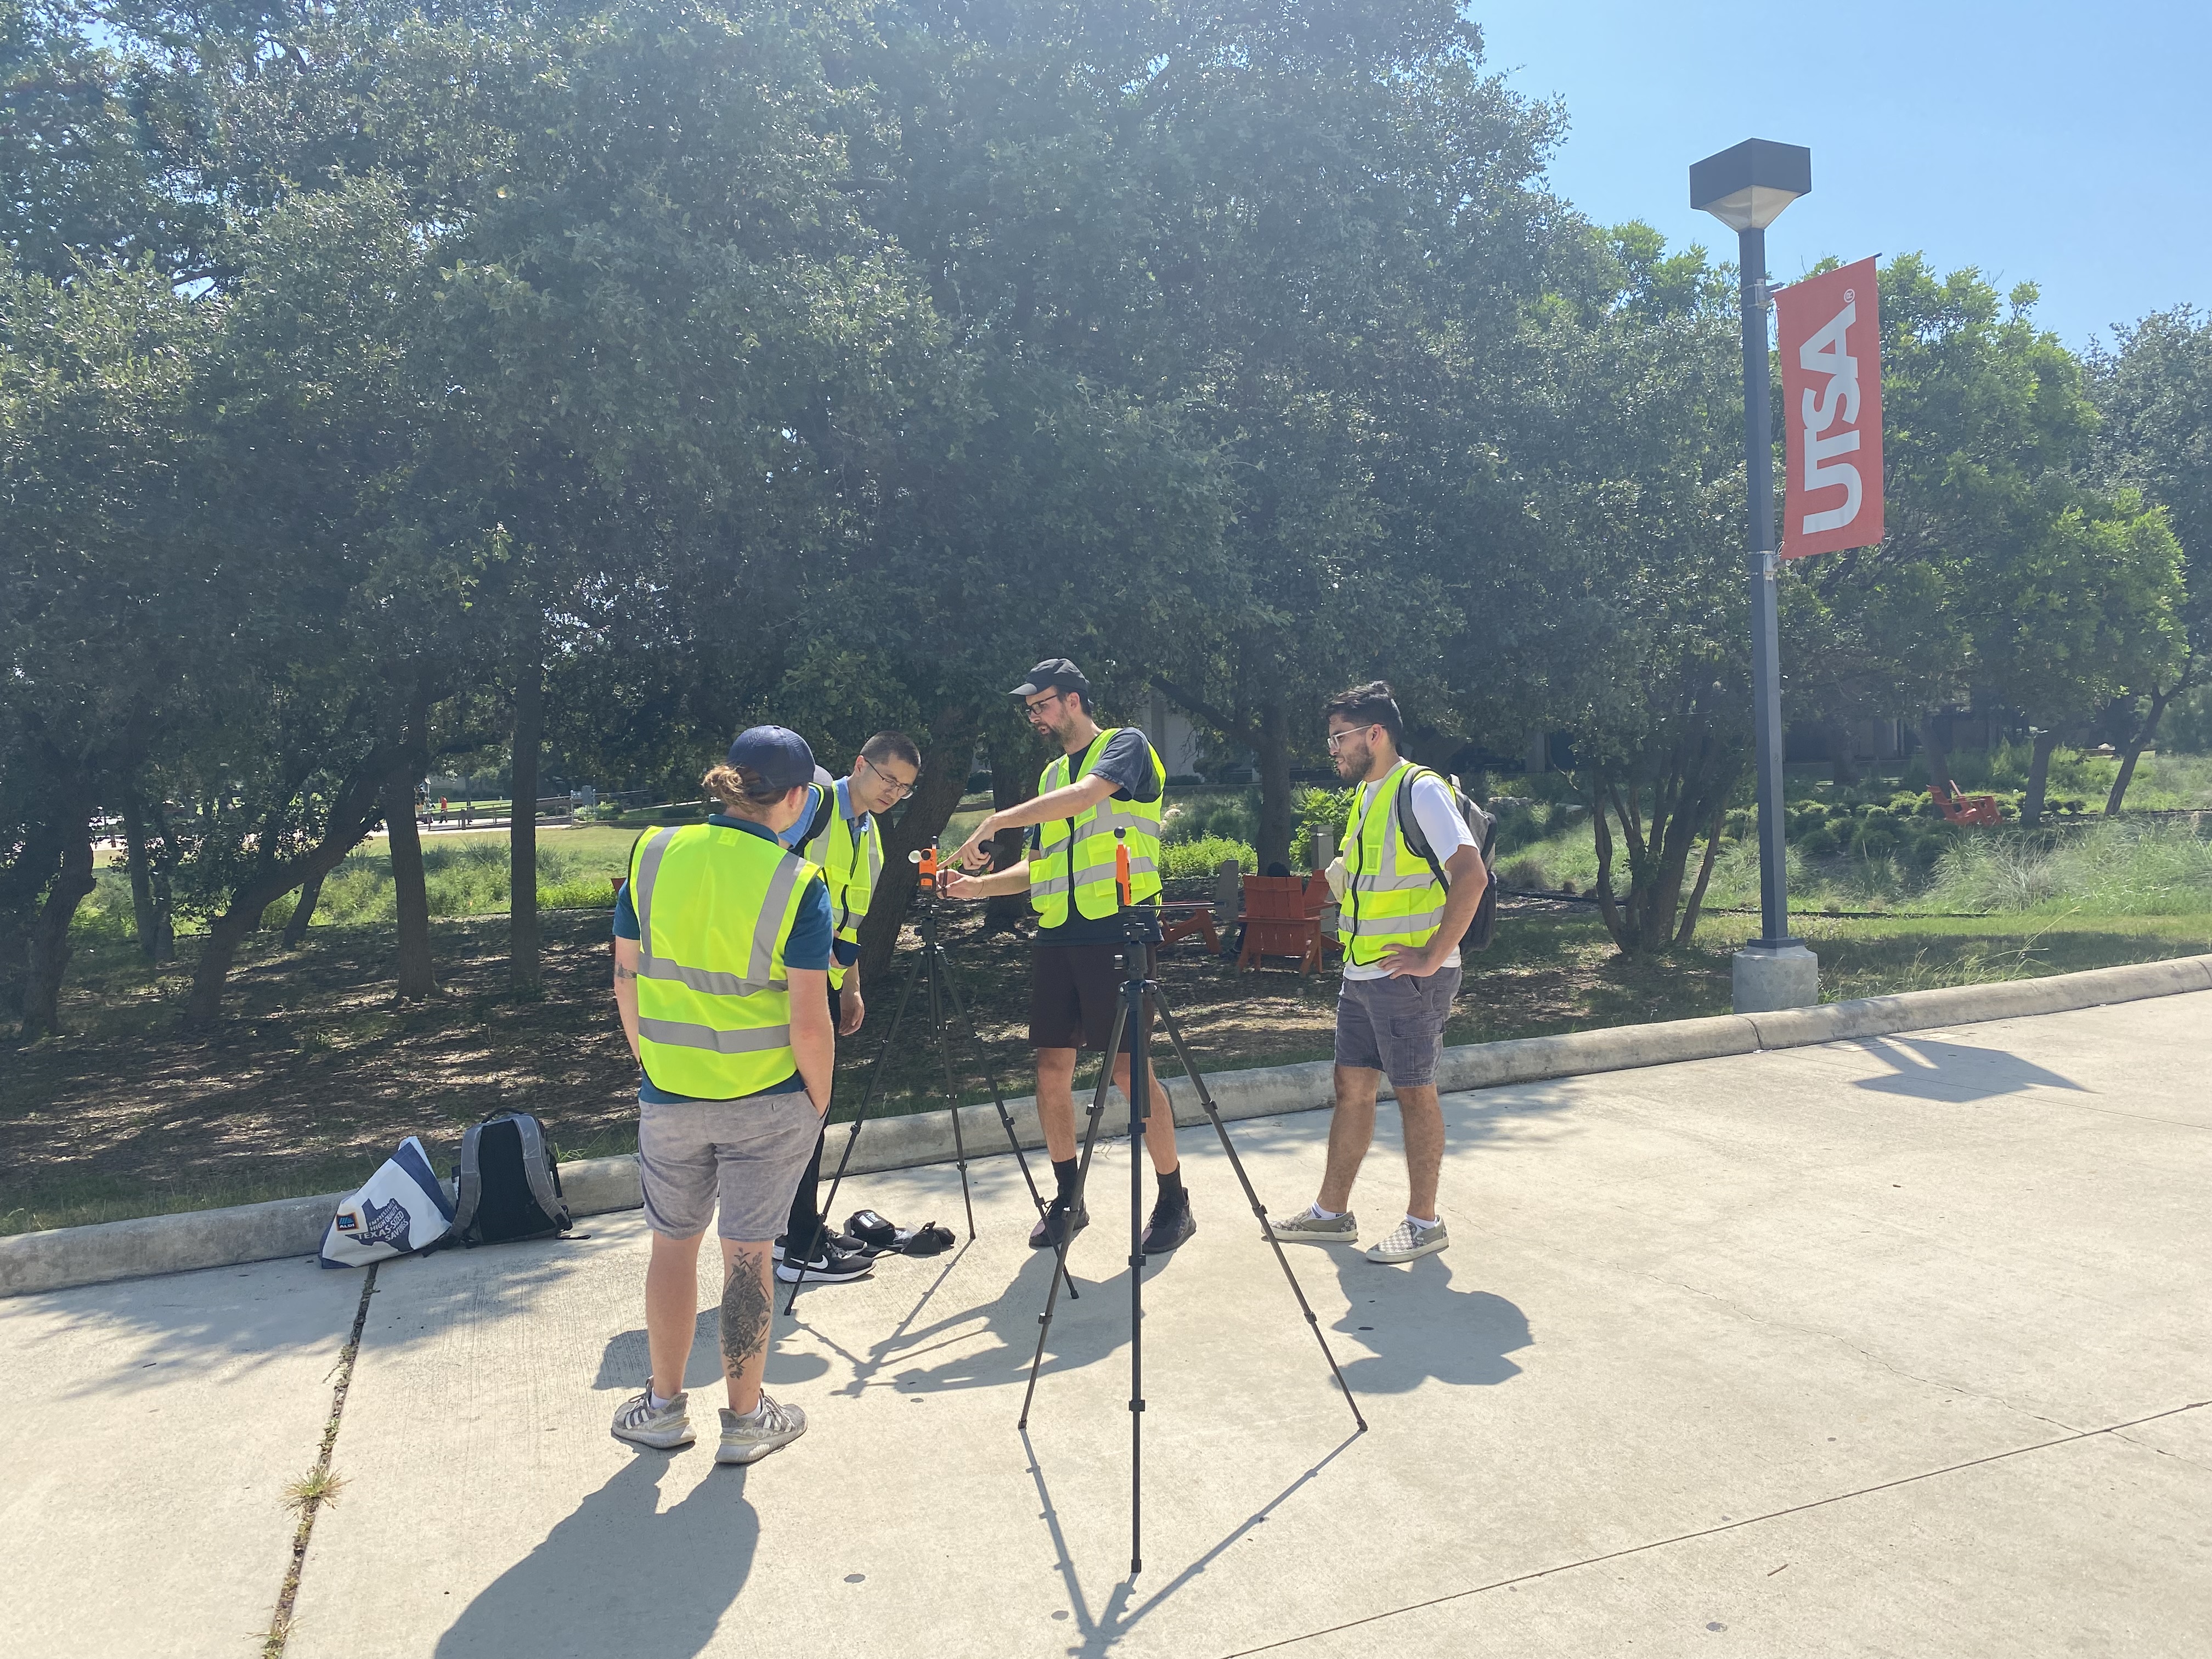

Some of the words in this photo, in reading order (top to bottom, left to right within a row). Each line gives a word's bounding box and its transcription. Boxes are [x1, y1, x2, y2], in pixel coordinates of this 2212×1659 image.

[1799, 300, 1863, 534] UTSA
[356, 1210, 404, 1239] TEXAS-SIZED
[370, 1219, 386, 1231] HIGH
[385, 1204, 399, 1223] QUALITY
[385, 1218, 409, 1241] SAVINGS
